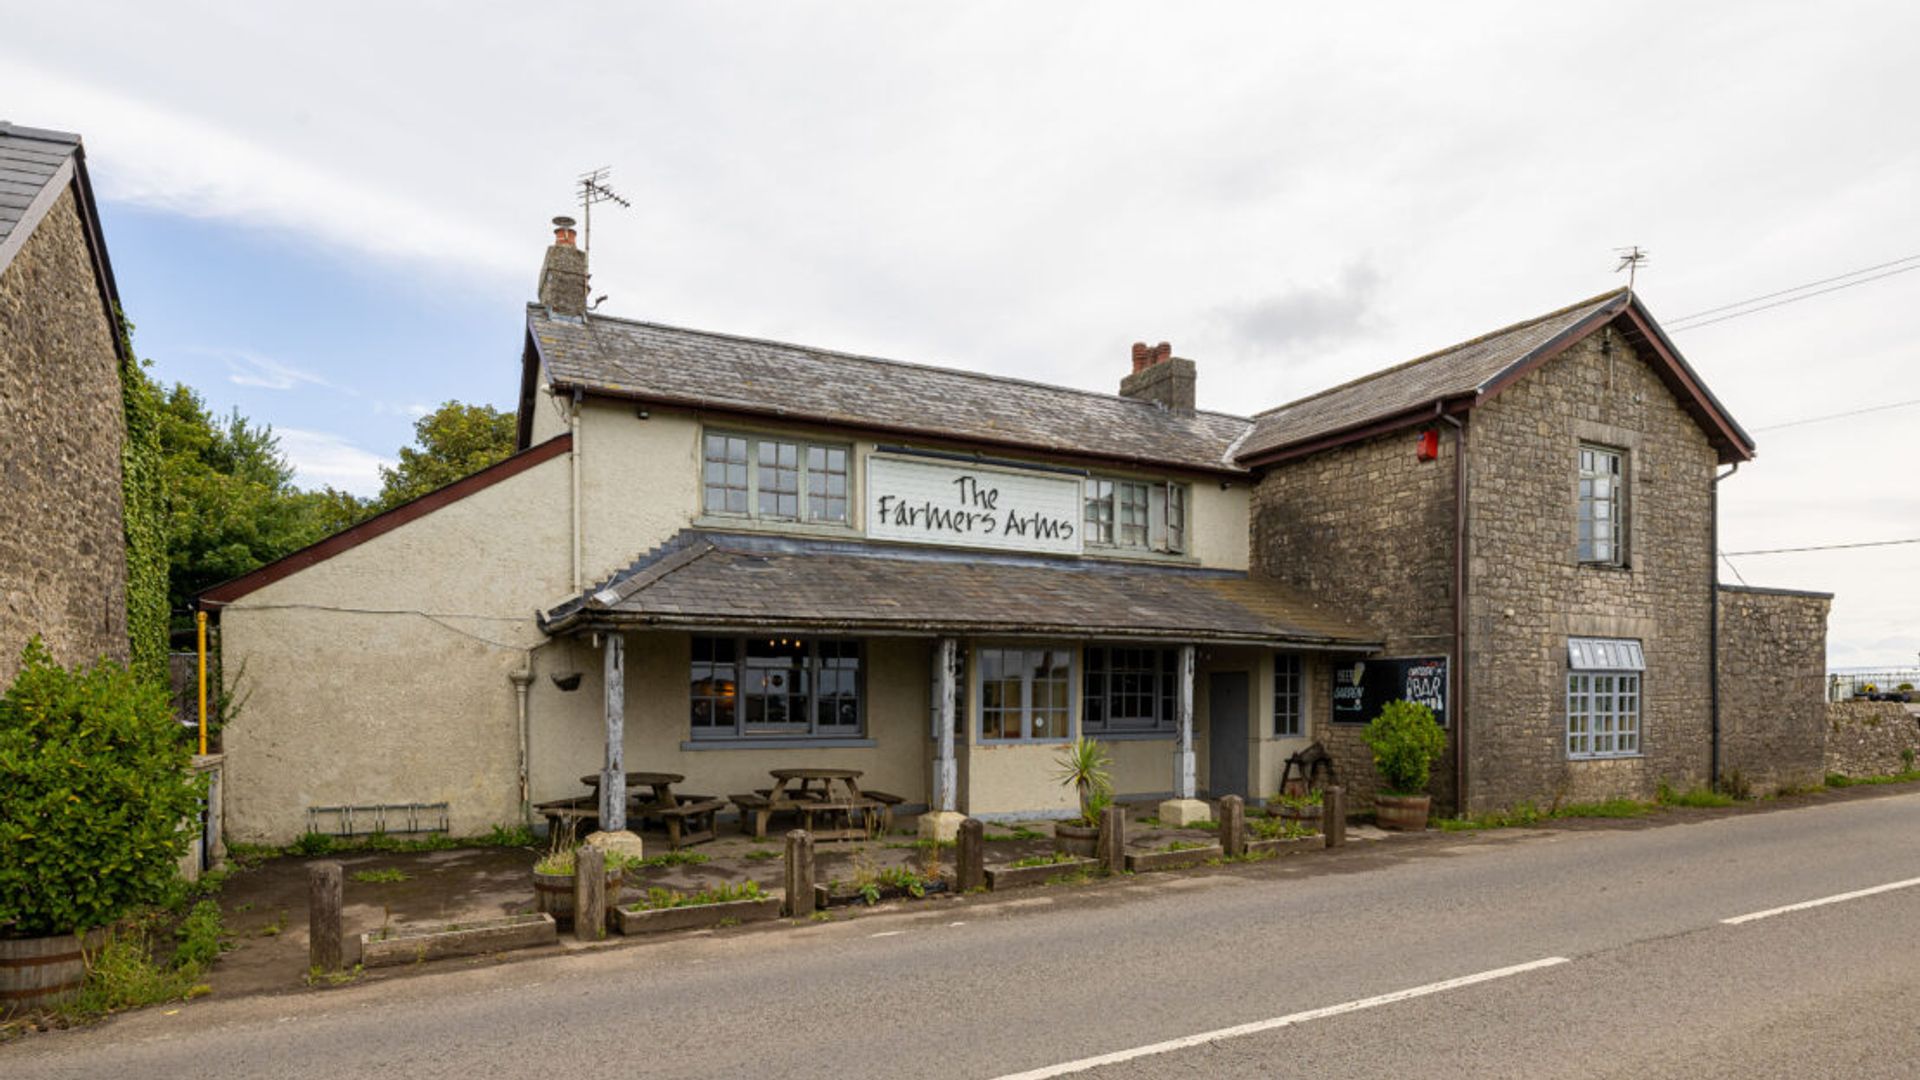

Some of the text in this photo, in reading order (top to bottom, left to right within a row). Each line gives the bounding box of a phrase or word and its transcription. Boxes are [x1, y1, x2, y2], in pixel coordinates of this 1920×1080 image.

[953, 476, 999, 510] The
[878, 495, 1074, 540] Farmers Arms
[1413, 676, 1441, 698] BAR
